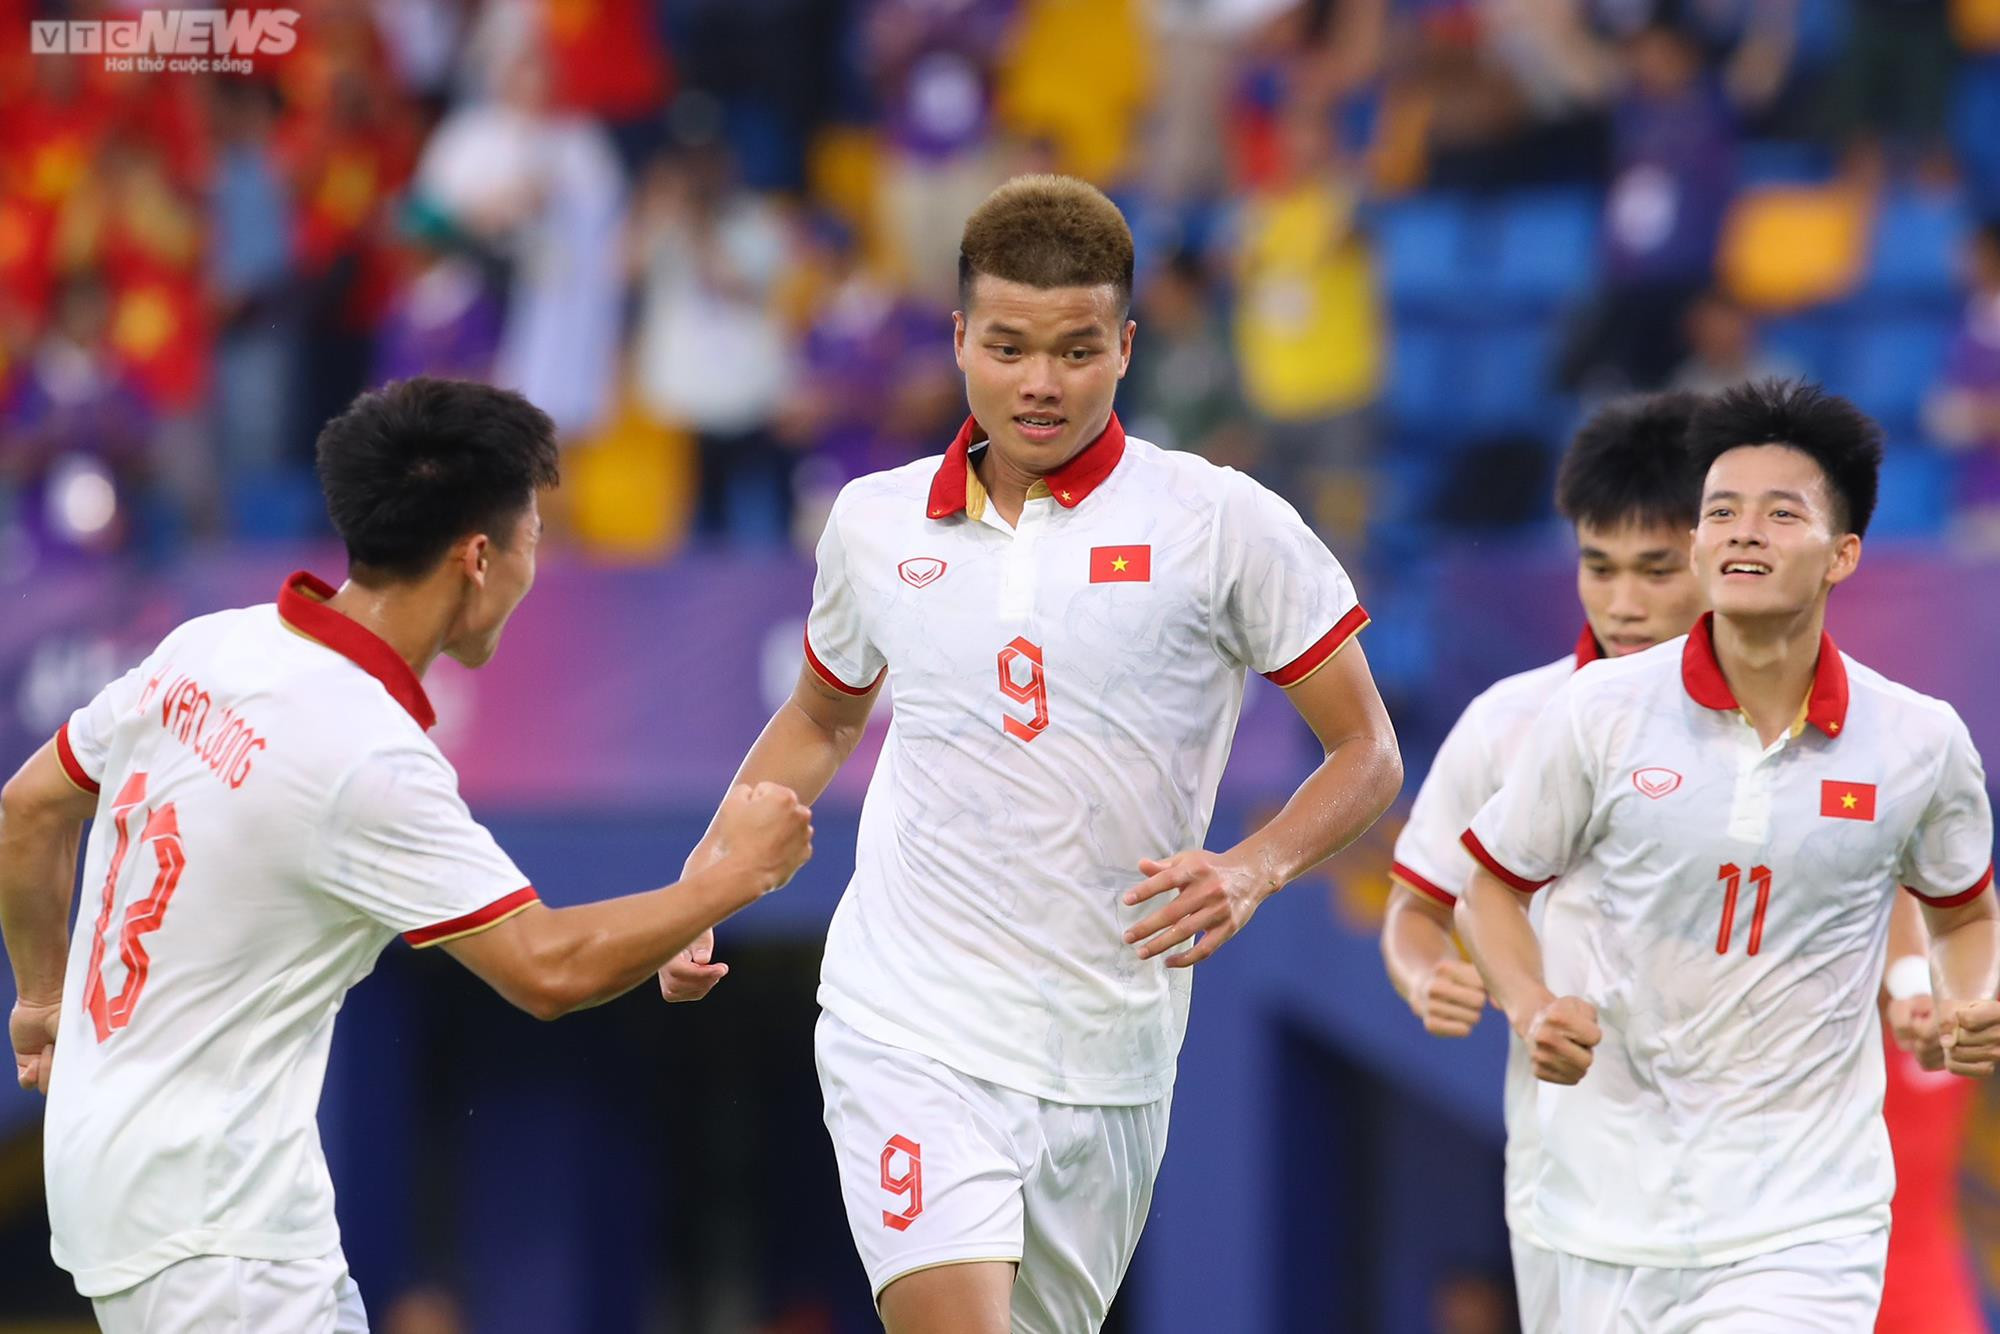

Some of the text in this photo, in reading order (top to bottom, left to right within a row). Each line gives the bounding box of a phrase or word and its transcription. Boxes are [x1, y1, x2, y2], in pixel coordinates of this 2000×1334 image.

[997, 635, 1050, 742] 9
[1715, 862, 1773, 956] 11
[880, 1133, 923, 1232] 9
